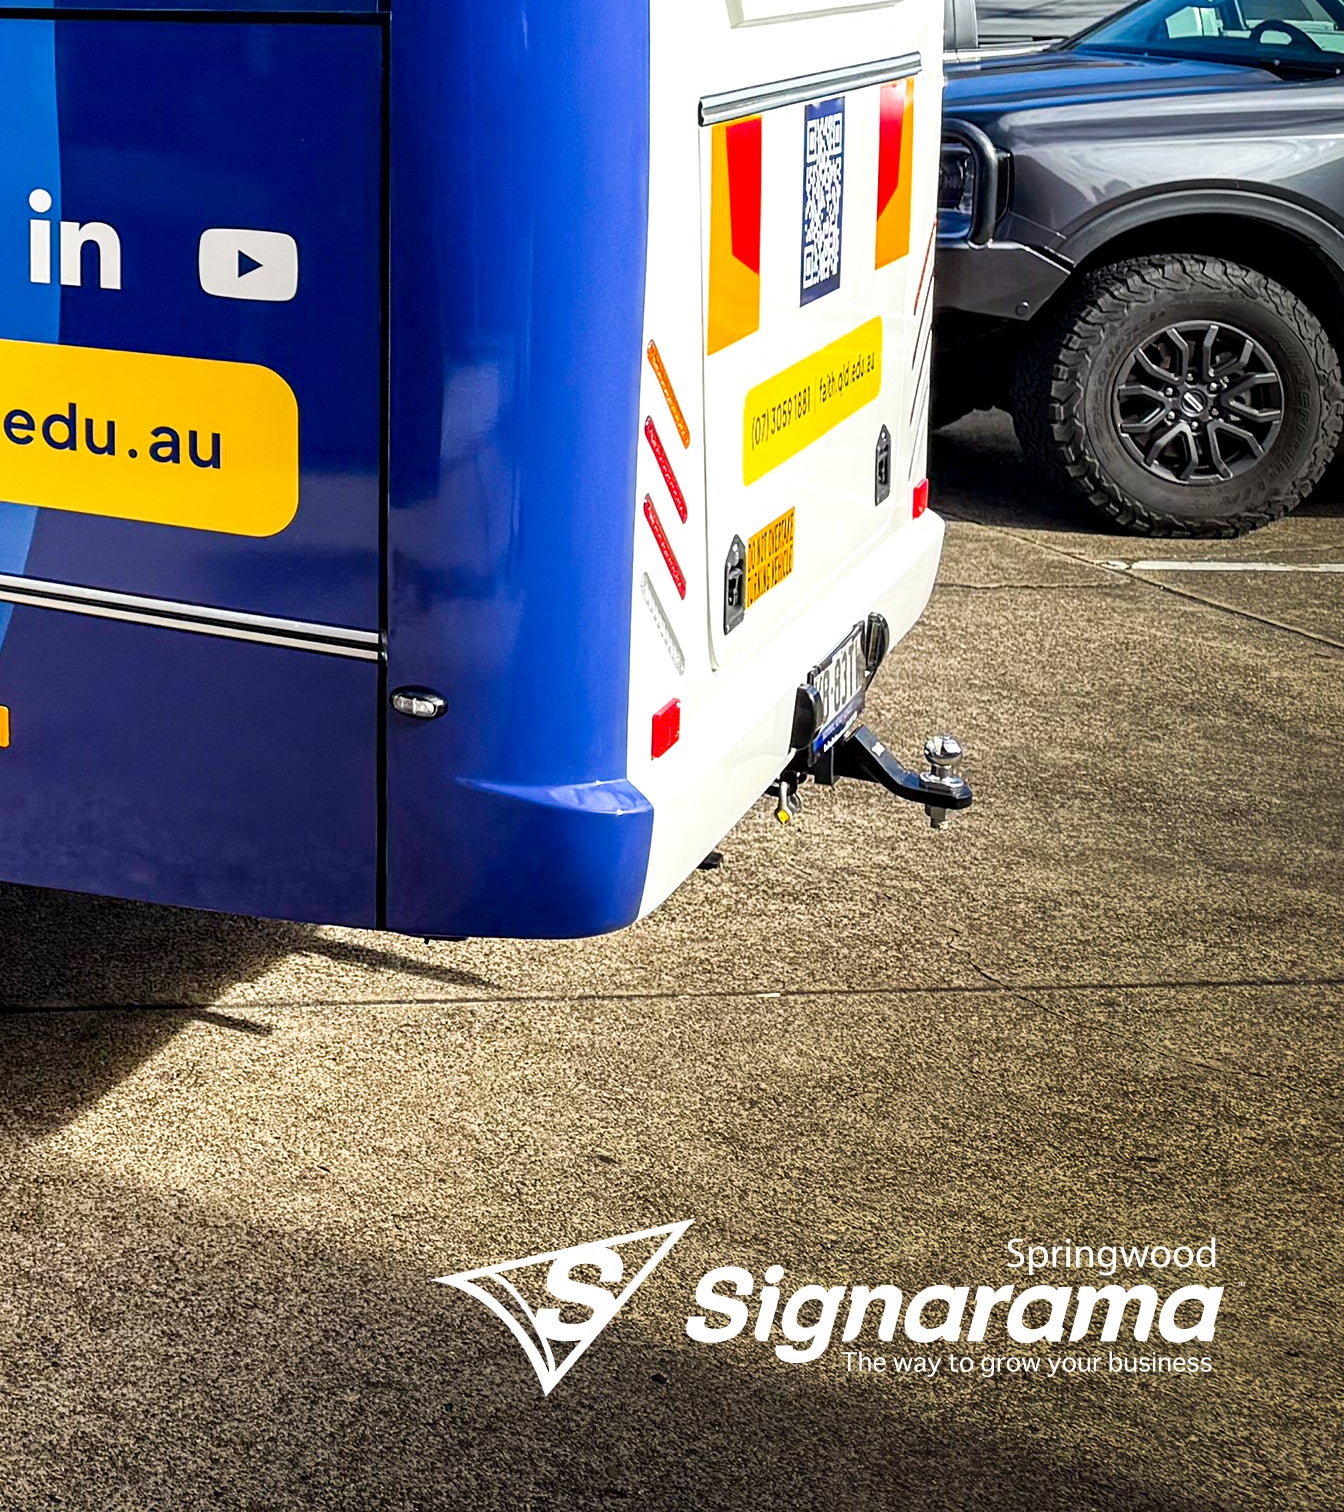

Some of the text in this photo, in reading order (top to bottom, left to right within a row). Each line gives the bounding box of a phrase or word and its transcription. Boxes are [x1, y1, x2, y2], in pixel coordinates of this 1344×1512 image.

[28, 188, 121, 290] in
[752, 351, 875, 451] (07) 3059 1881 faith.qld.edu.au
